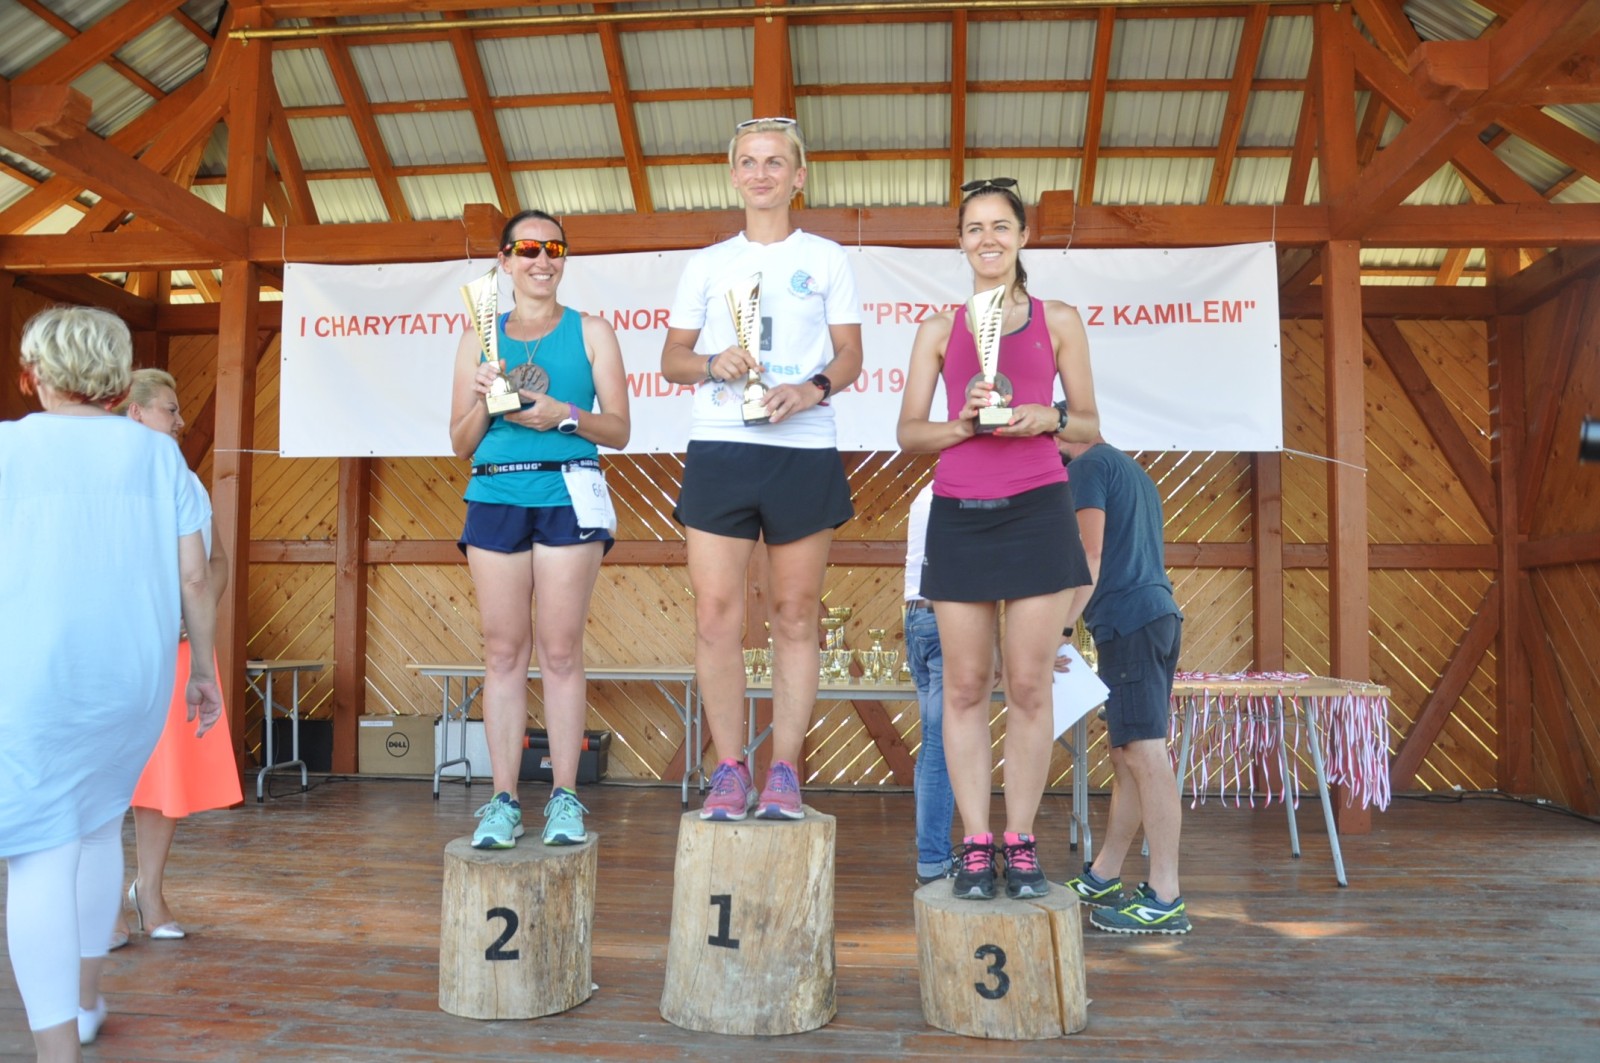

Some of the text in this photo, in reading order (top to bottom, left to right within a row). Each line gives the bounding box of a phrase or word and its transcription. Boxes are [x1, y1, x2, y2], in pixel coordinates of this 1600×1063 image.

[300, 316, 306, 337] I
[1087, 306, 1105, 326] Z
[1113, 300, 1256, 326] KAMILEM"
[626, 368, 905, 398] WIDA 019
[485, 907, 519, 960] 2
[708, 894, 740, 949] 1
[974, 944, 1010, 1000] 3
